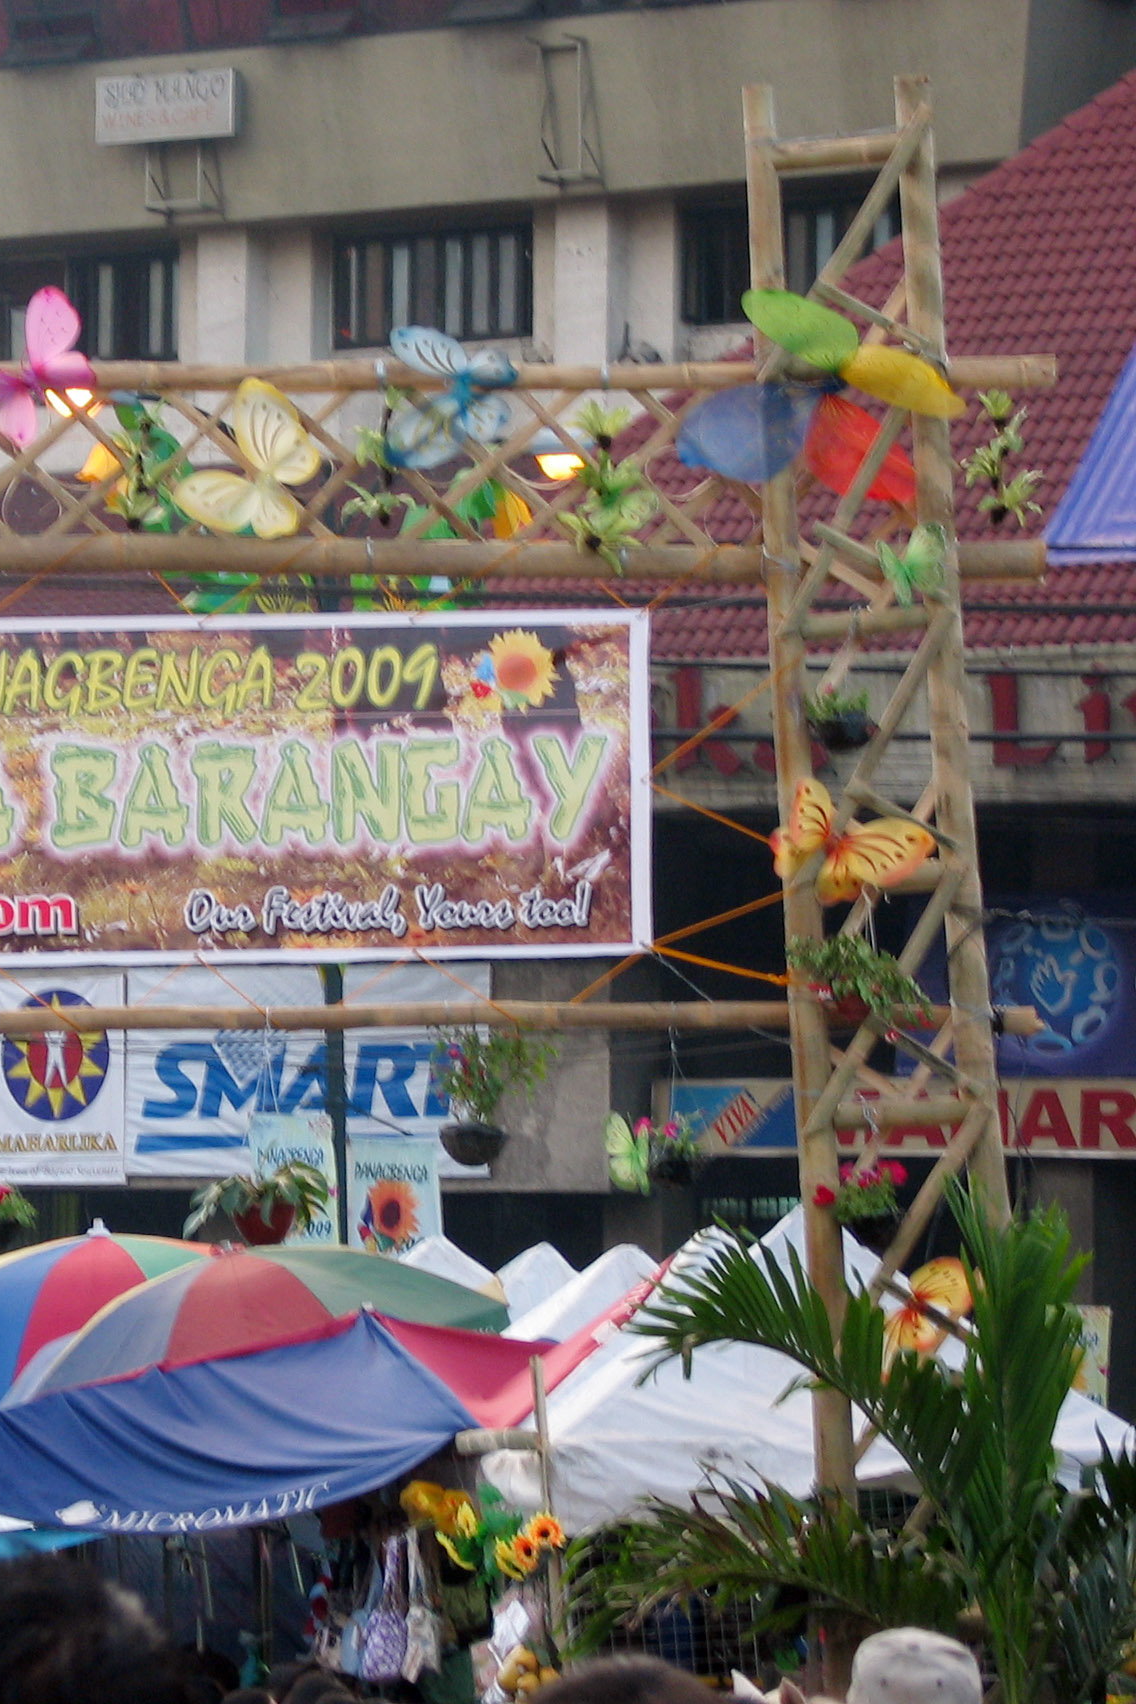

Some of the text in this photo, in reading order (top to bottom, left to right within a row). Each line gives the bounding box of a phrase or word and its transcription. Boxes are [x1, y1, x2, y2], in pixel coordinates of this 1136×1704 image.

[295, 643, 438, 709] 2009
[51, 732, 608, 850] BARANGAY
[187, 881, 592, 935] Our Festival, Yours too!
[712, 1094, 758, 1146] VIVA
[354, 1160, 428, 1183] PANAGBENGA
[101, 1481, 330, 1532] MICROMATIC
